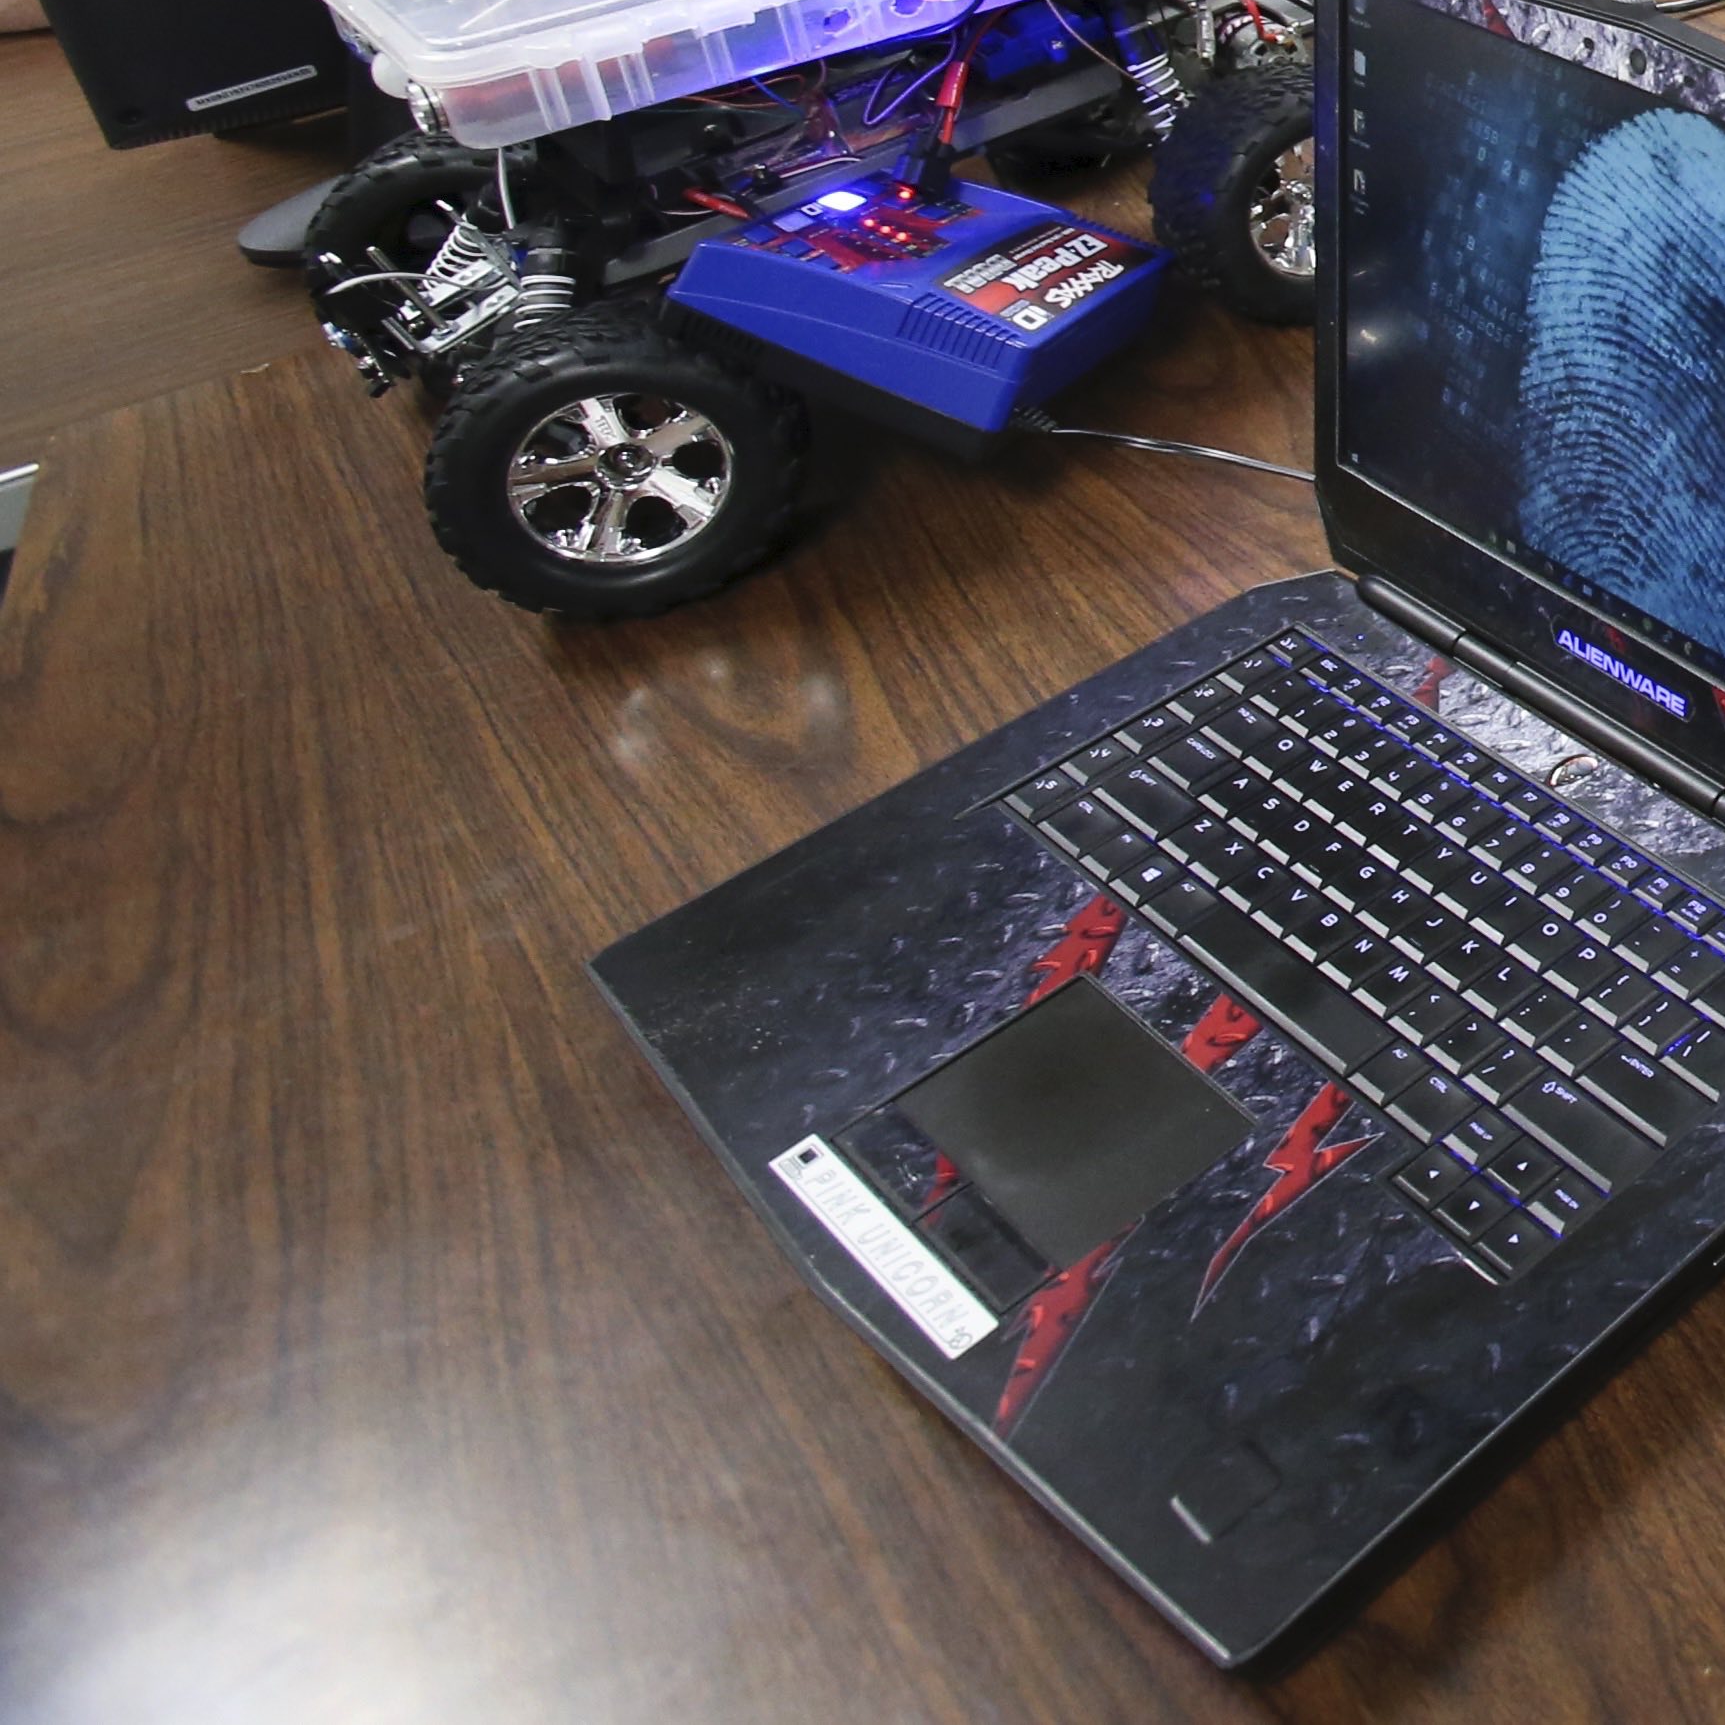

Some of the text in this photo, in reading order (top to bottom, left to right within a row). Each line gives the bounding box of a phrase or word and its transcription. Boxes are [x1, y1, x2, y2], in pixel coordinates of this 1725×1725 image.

[1557, 629, 1687, 717] ALIENWARE
[1193, 819, 1213, 833] Z
[1224, 841, 1244, 856] X
[1256, 865, 1275, 880] C
[1289, 887, 1309, 902] V
[1320, 913, 1340, 927] B
[1353, 938, 1374, 954] N
[1388, 965, 1410, 983] M
[1232, 776, 1249, 791] A
[1262, 797, 1281, 812] S
[1293, 819, 1310, 832] D
[1324, 841, 1343, 854] F
[1358, 865, 1377, 879] G
[1390, 889, 1411, 904] H
[1425, 916, 1444, 928] J
[1461, 938, 1481, 955] K
[1497, 966, 1513, 982] L
[1277, 738, 1294, 753] Q
[1308, 759, 1329, 774] W
[1337, 780, 1355, 793] E
[1368, 801, 1388, 817] R
[1403, 823, 1419, 836] T
[1436, 847, 1453, 861] Y
[1469, 870, 1489, 886] U
[1541, 922, 1560, 937] O
[1577, 947, 1597, 962] P
